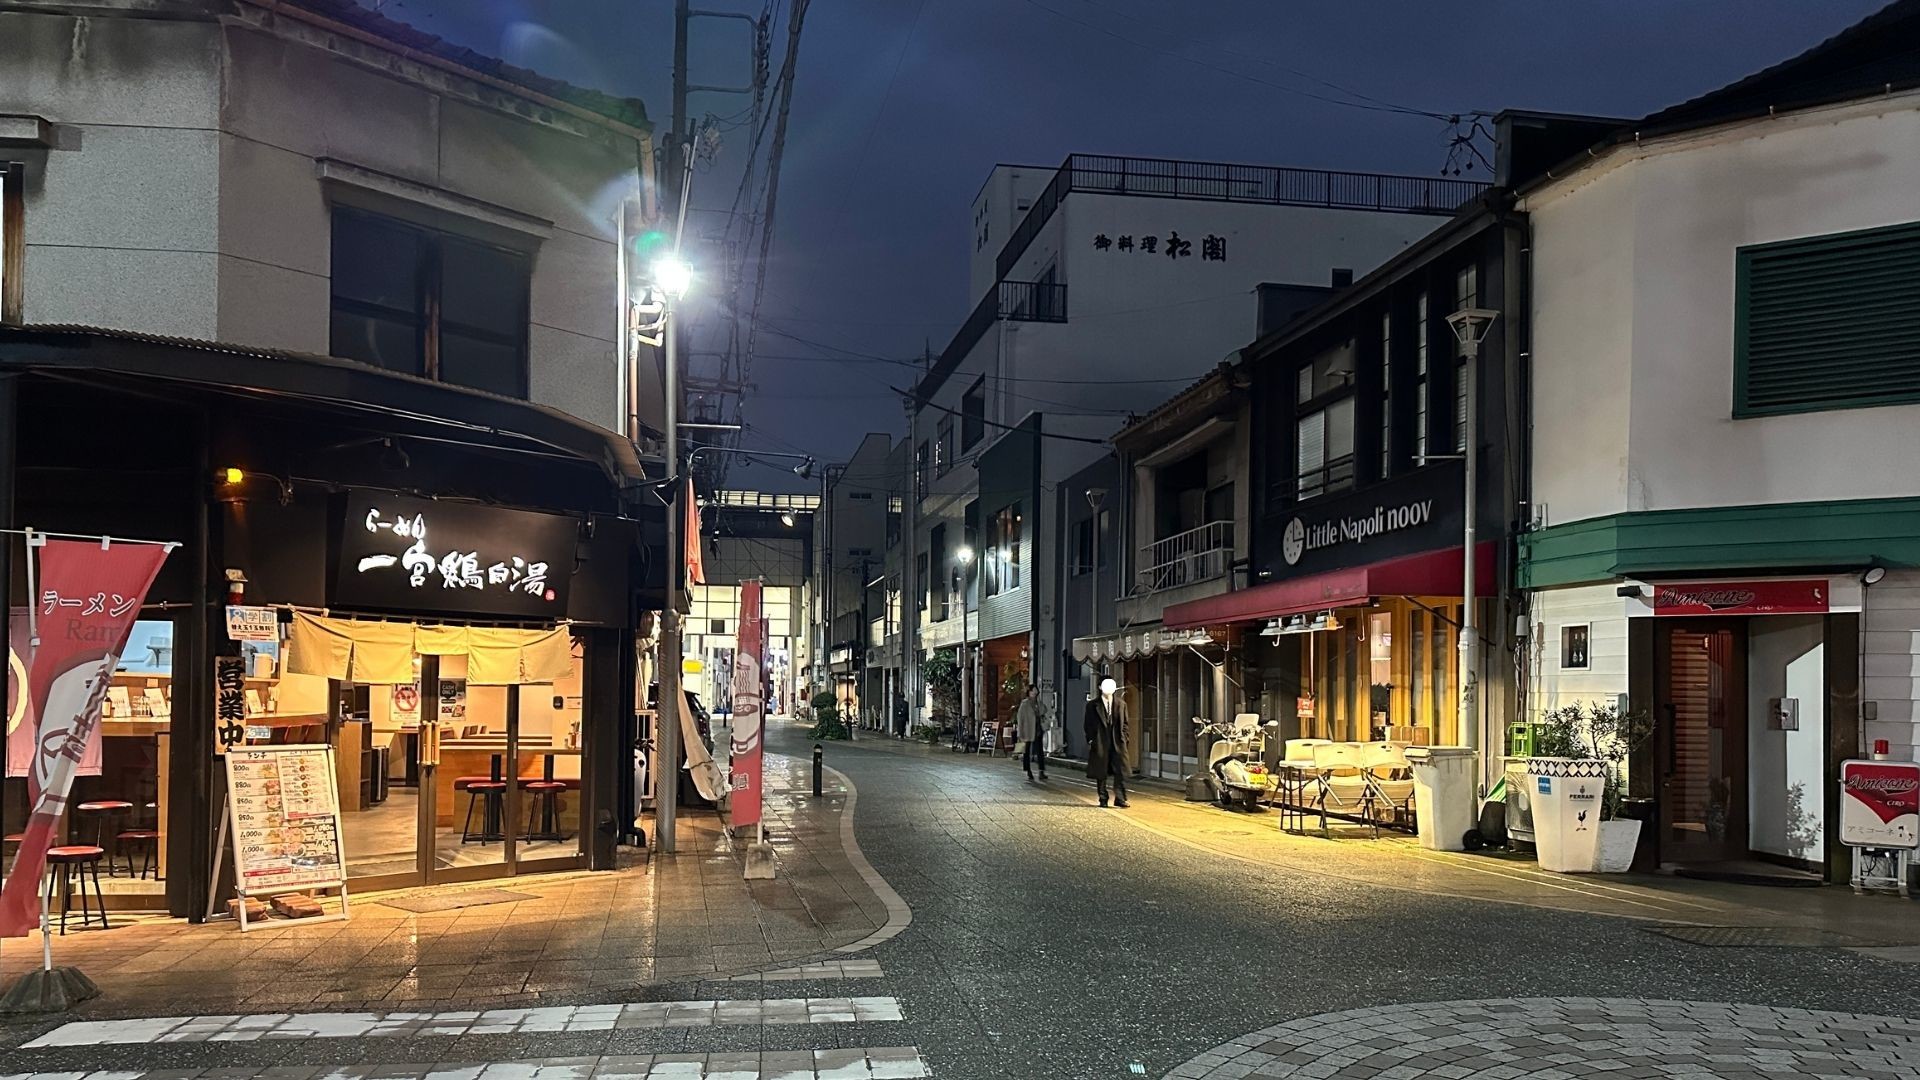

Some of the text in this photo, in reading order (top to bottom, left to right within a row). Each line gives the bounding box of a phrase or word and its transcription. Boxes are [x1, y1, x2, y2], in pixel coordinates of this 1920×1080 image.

[365, 508, 426, 539] らーめん
[1306, 500, 1432, 550] Little Napoli noov
[42, 591, 136, 617] ラーメン
[1657, 587, 1755, 609] Amicone
[217, 660, 246, 750] 営業中
[1845, 773, 1919, 793] Amicone
[1847, 825, 1895, 836] アミコーネ
